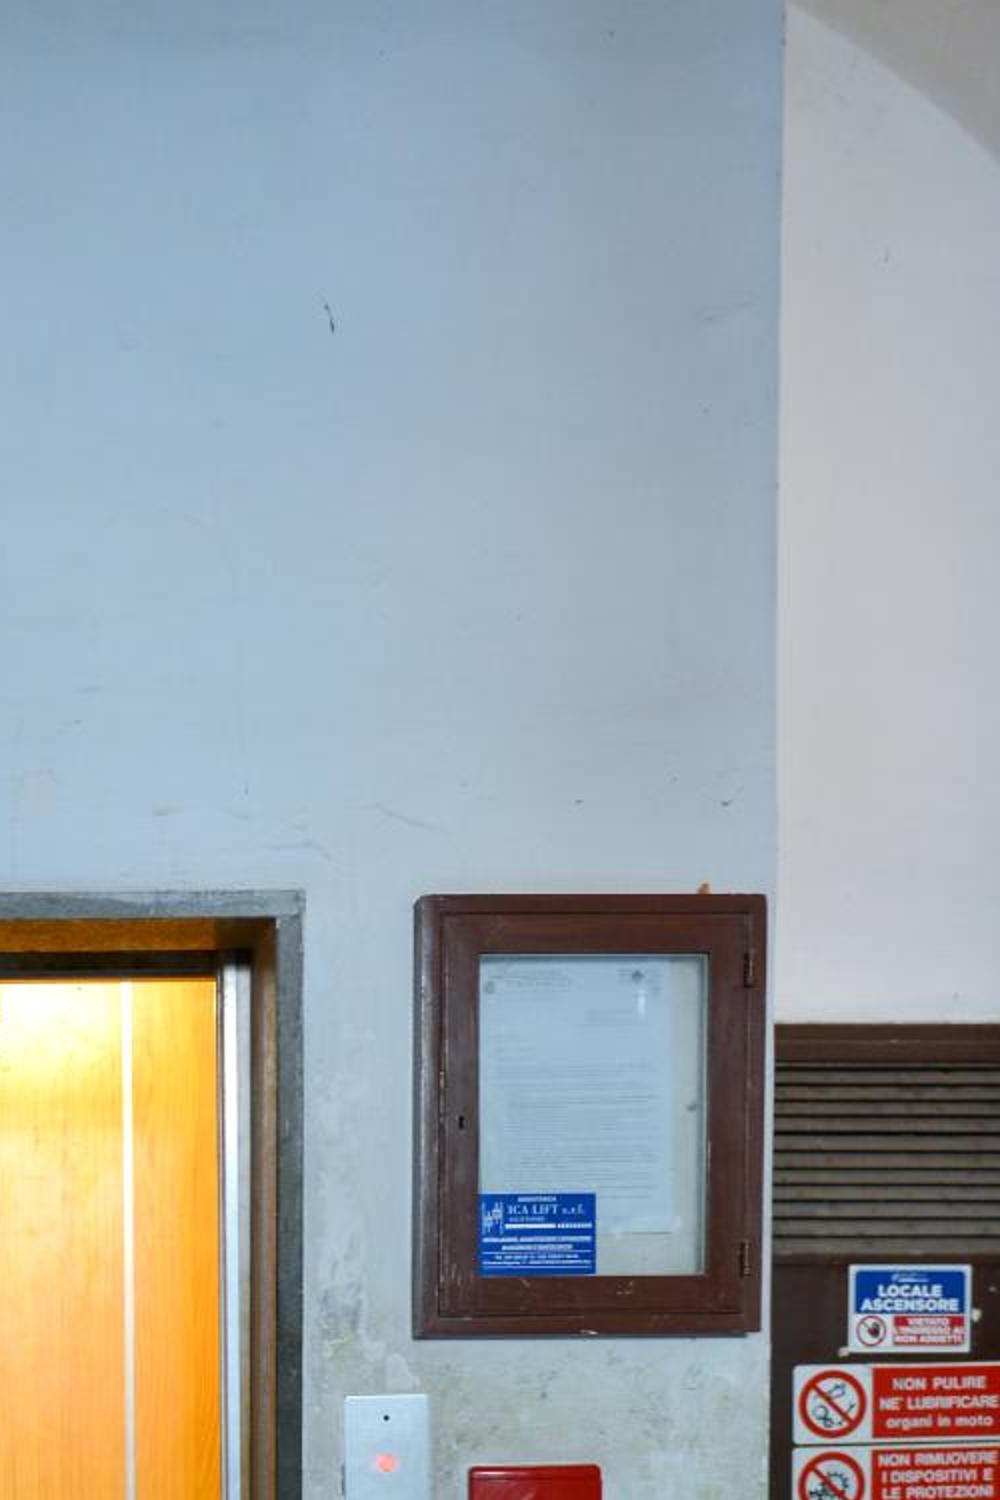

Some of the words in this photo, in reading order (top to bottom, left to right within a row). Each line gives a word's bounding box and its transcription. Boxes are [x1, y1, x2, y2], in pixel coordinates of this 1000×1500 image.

[877, 1283, 943, 1297] LOCALE
[860, 1297, 959, 1311] ASCENSORE
[893, 1376, 927, 1391] NON
[932, 1375, 986, 1390] PULIRE
[906, 1394, 1000, 1411] LUBRIFICARE
[886, 1413, 932, 1431] organi
[937, 1412, 952, 1427] in
[954, 1414, 994, 1427] moto
[878, 1453, 911, 1467] NON
[914, 1450, 999, 1466] RIMUOVERE
[881, 1470, 887, 1484] I
[890, 1468, 978, 1484] DISPOSITIVI
[982, 1467, 994, 1481] E
[881, 1486, 901, 1500] LE
[905, 1484, 994, 1500] PROTEZIONI
